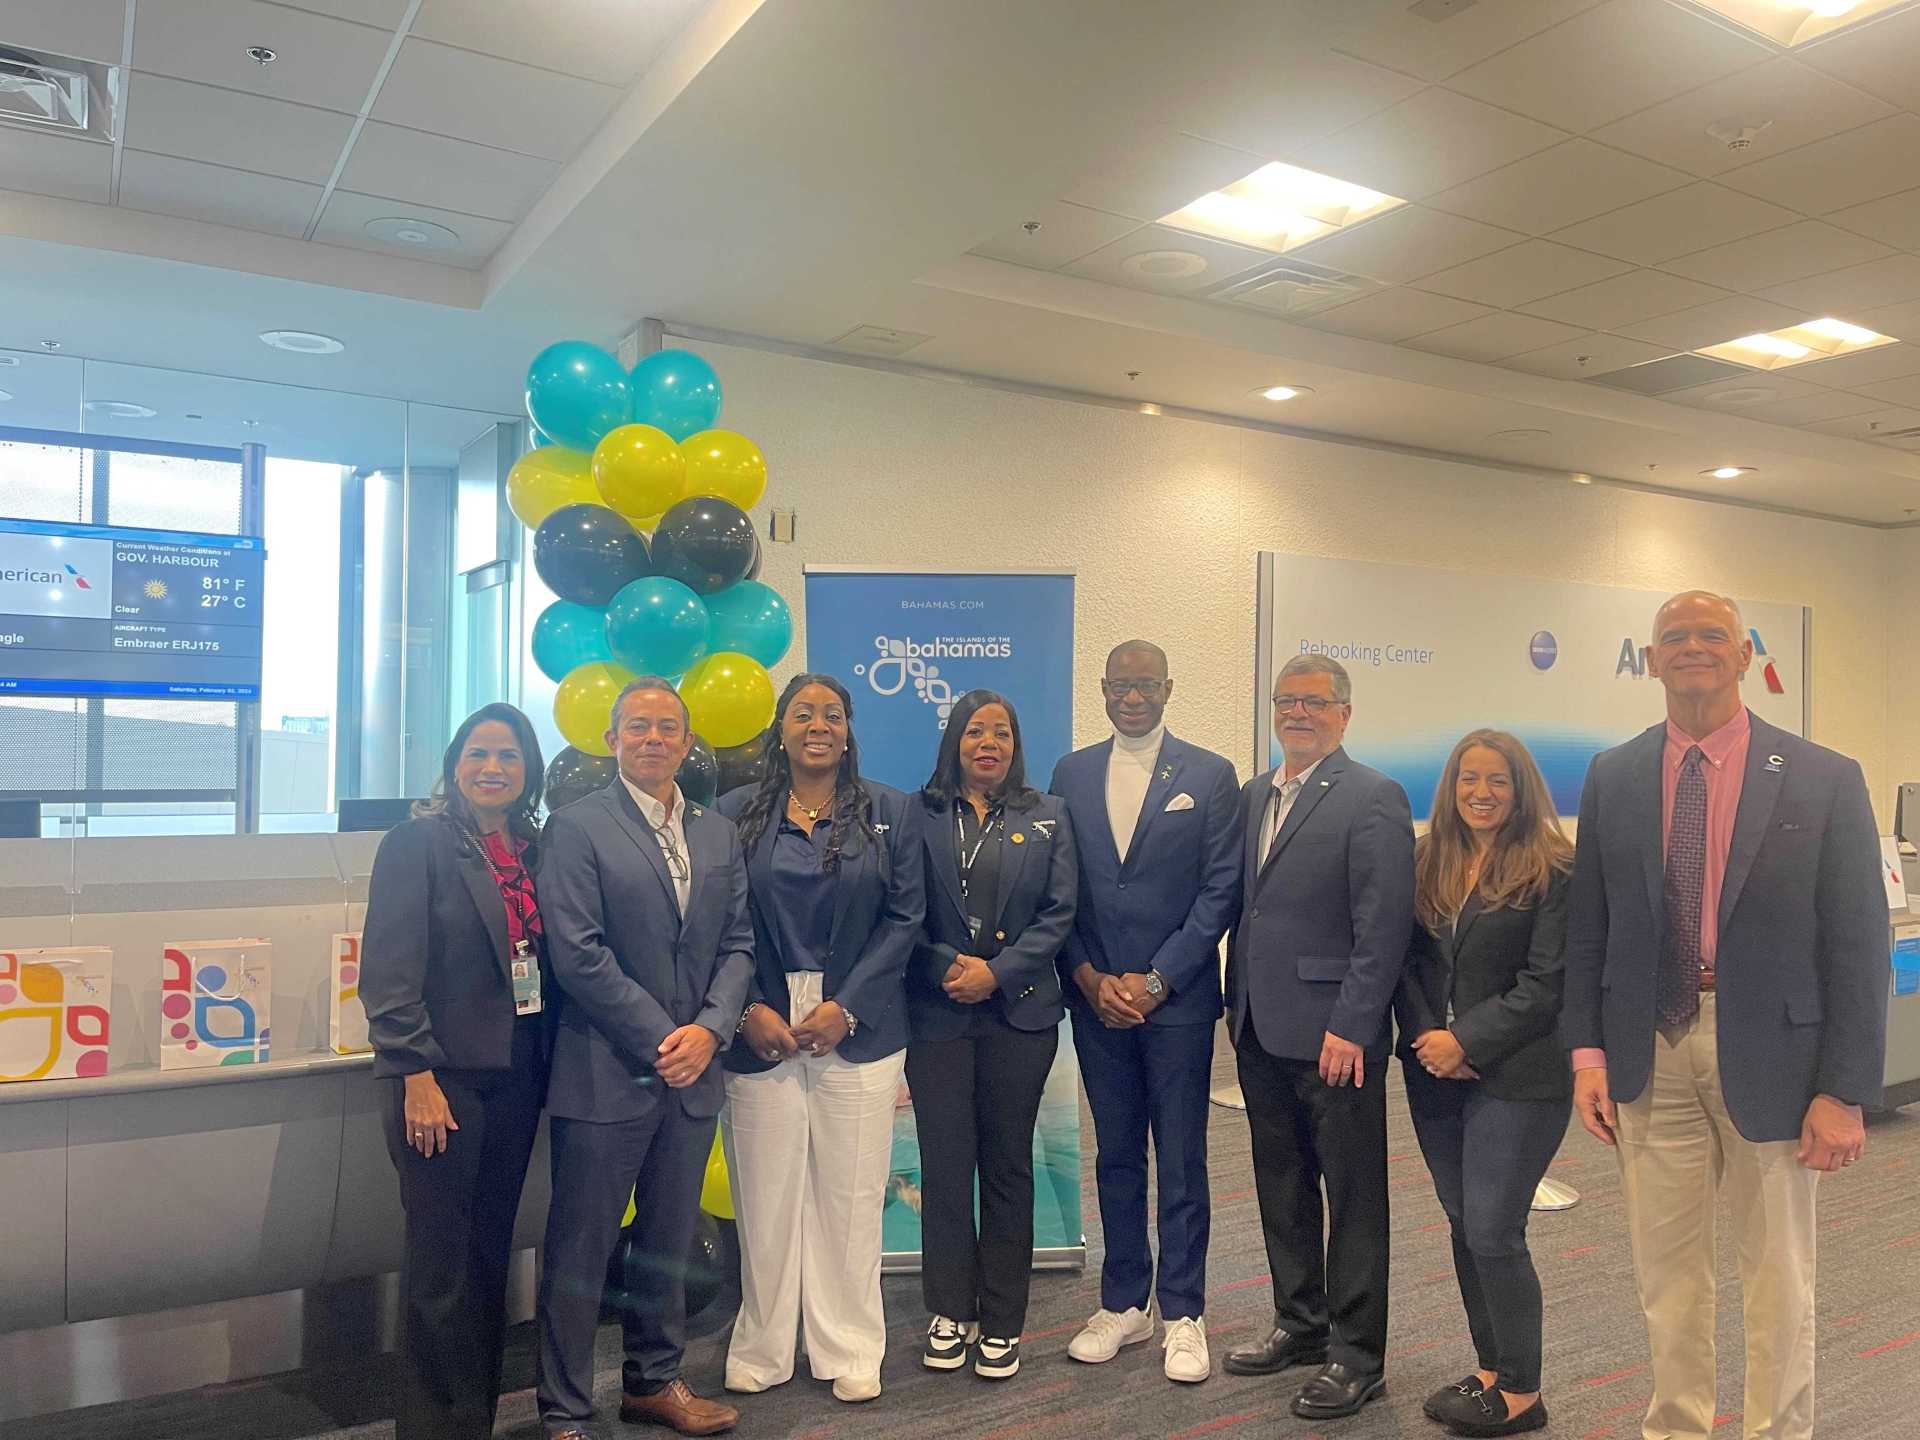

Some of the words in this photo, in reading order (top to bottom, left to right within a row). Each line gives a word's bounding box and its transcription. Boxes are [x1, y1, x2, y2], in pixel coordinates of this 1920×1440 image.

[116, 552, 148, 563] GOV.
[152, 555, 219, 568] HARBOUR
[0, 568, 63, 583] erican
[235, 579, 246, 591] F
[114, 605, 140, 614] Clear
[234, 596, 246, 609] C
[114, 637, 169, 649] Embraer
[172, 640, 220, 651] ERJ175
[906, 636, 1012, 658] bahamas
[1299, 639, 1382, 666] Rebooking
[1385, 644, 1434, 664] Center
